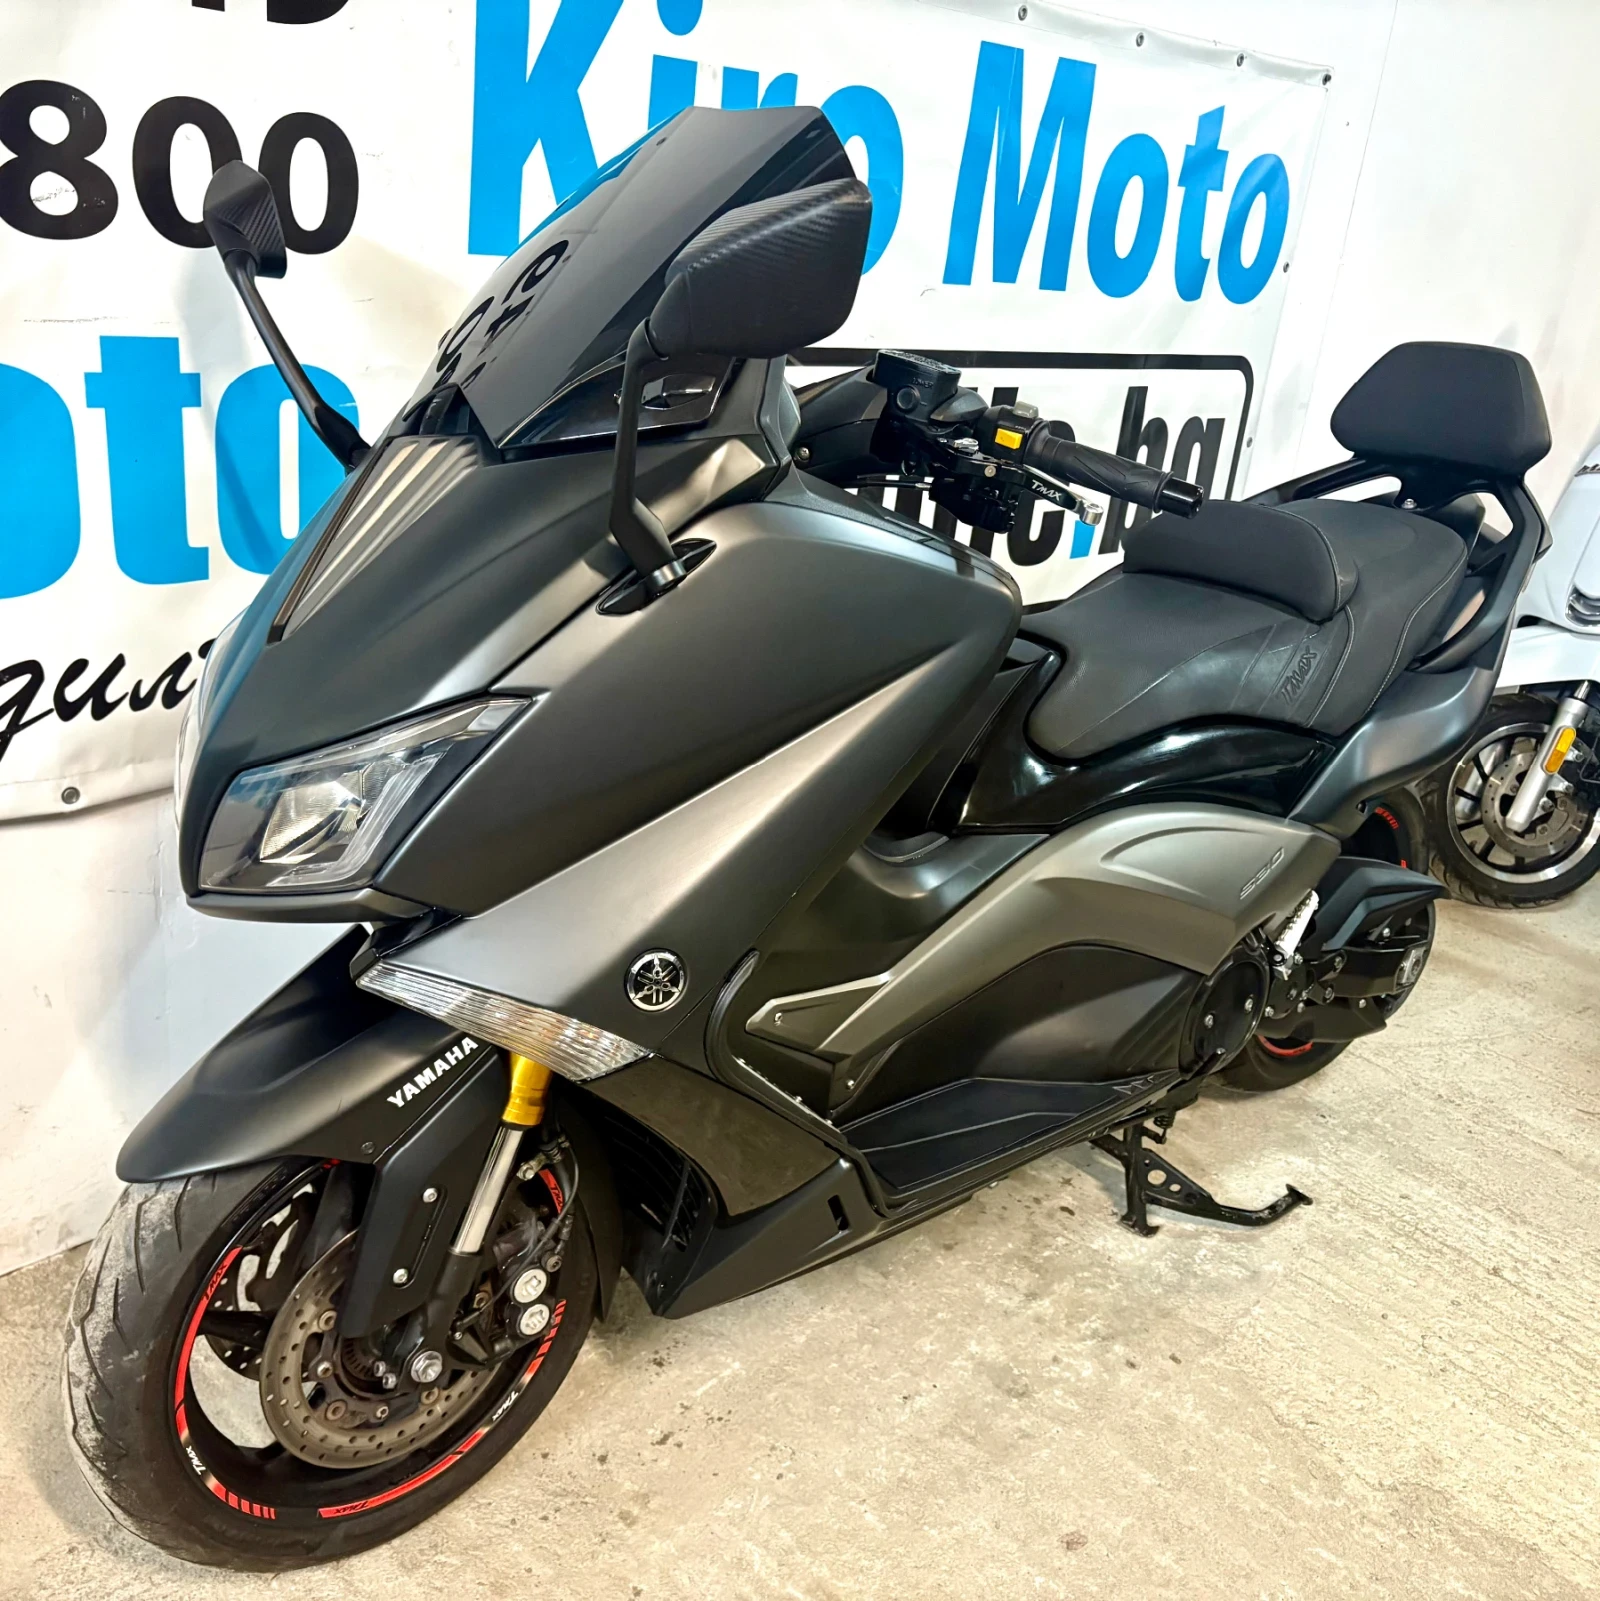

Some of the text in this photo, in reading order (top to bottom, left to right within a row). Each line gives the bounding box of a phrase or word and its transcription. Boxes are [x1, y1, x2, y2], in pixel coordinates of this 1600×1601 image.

[0, 80, 359, 255] 800
[468, 0, 1290, 304] Kio Moto
[1031, 479, 1062, 501] TMAX
[1276, 645, 1317, 705] TMAX
[1240, 848, 1284, 900] 530
[386, 1036, 479, 1108] YAMAHA
[186, 1445, 206, 1475] TMAX
